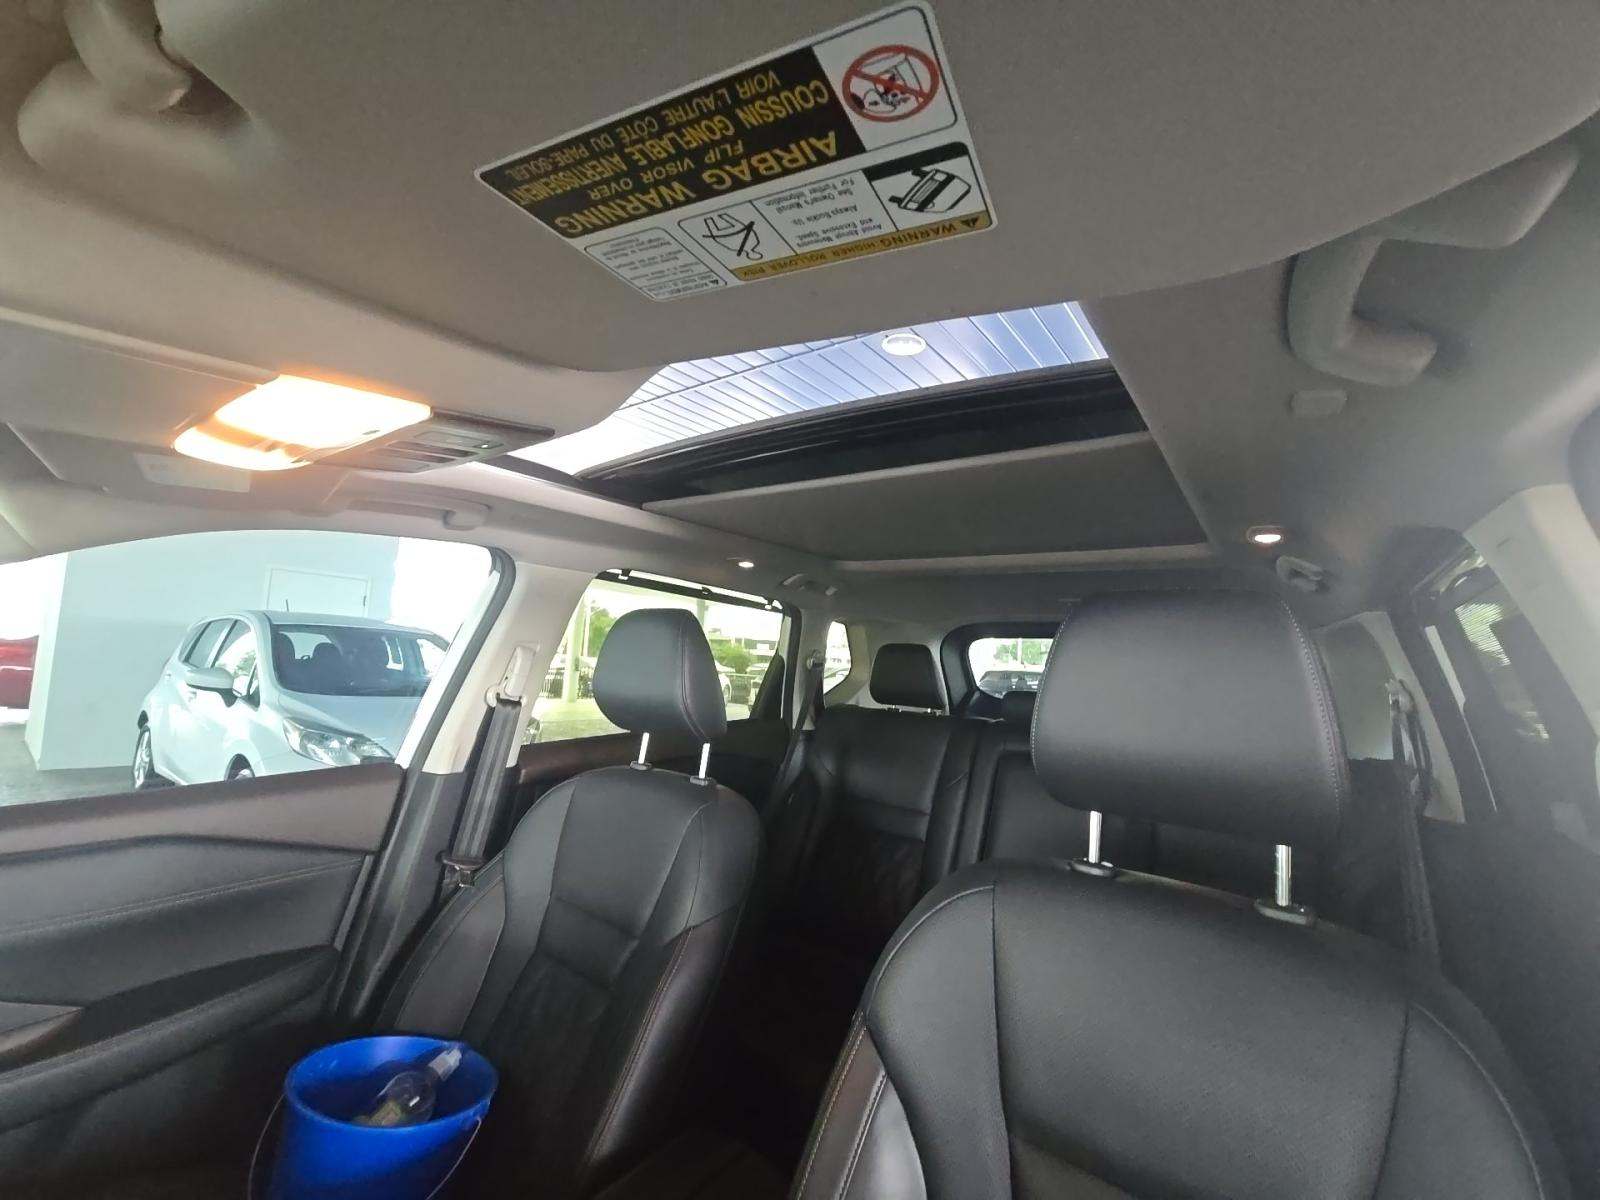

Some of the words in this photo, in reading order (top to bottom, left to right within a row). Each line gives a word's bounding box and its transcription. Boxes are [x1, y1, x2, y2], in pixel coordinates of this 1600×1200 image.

[731, 68, 782, 99] VOIR
[657, 88, 734, 126] L'AUTRE
[731, 77, 833, 129] COUSSIN
[584, 133, 618, 153] DU
[610, 115, 666, 146] CÔTÉ
[619, 111, 738, 166] GONFLABLE
[501, 142, 595, 182] PARE-SOLEIL
[696, 130, 847, 192] AIRBAG
[697, 138, 749, 164] FLIP
[501, 152, 633, 206] AVERTISSEMENT
[634, 156, 698, 184] VISOR
[581, 176, 639, 201] OVER
[802, 192, 836, 206] Owner's
[806, 182, 838, 196] Further
[548, 178, 699, 234] WARNING
[774, 201, 804, 214] Manual
[829, 203, 859, 217] Always
[860, 223, 883, 233] Avoid
